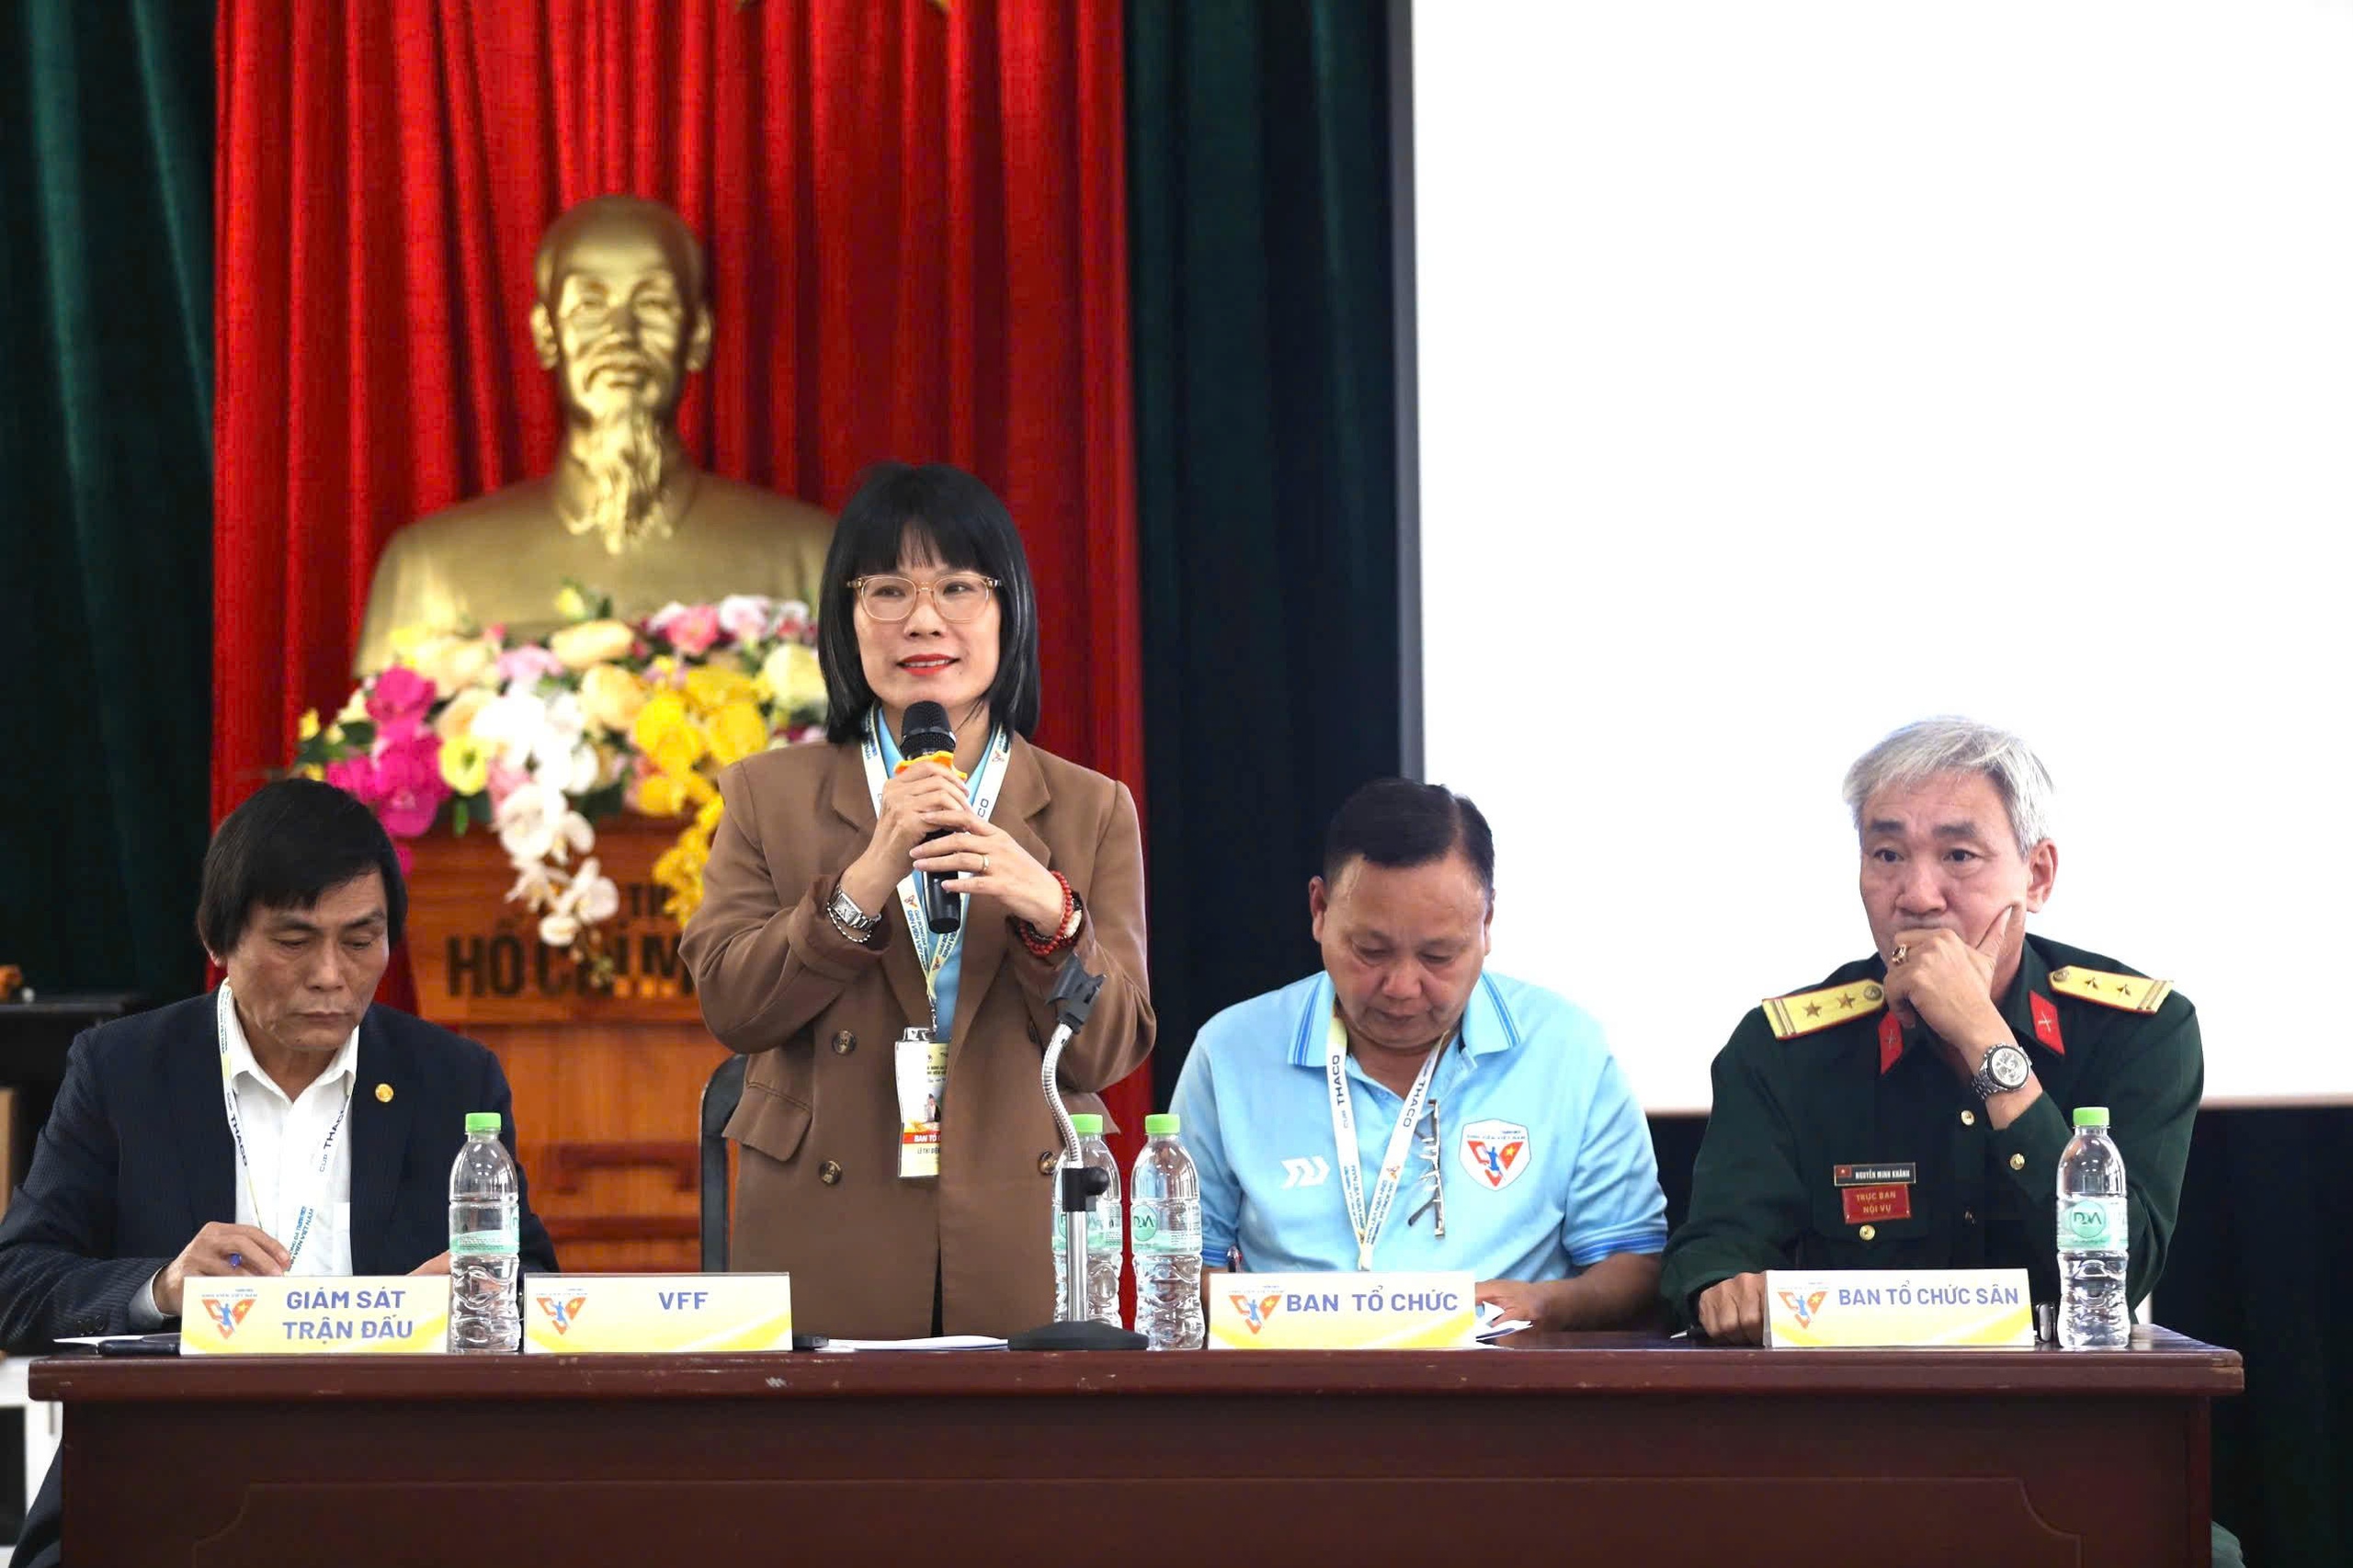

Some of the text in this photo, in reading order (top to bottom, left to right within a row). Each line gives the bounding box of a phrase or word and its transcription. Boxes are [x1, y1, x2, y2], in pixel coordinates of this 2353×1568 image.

[1332, 1054, 1345, 1106] THACO
[1403, 1080, 1426, 1128] THACO
[1879, 1191, 1896, 1199] BAN
[287, 1287, 405, 1310] GIÁM SÁT
[658, 1291, 709, 1310] VFF
[1287, 1285, 1458, 1312] BAN TỔ CHỨC
[1838, 1280, 2018, 1305] BAN TỔ CHỨC SÂN
[282, 1314, 413, 1345] TRẬN ĐẤU
